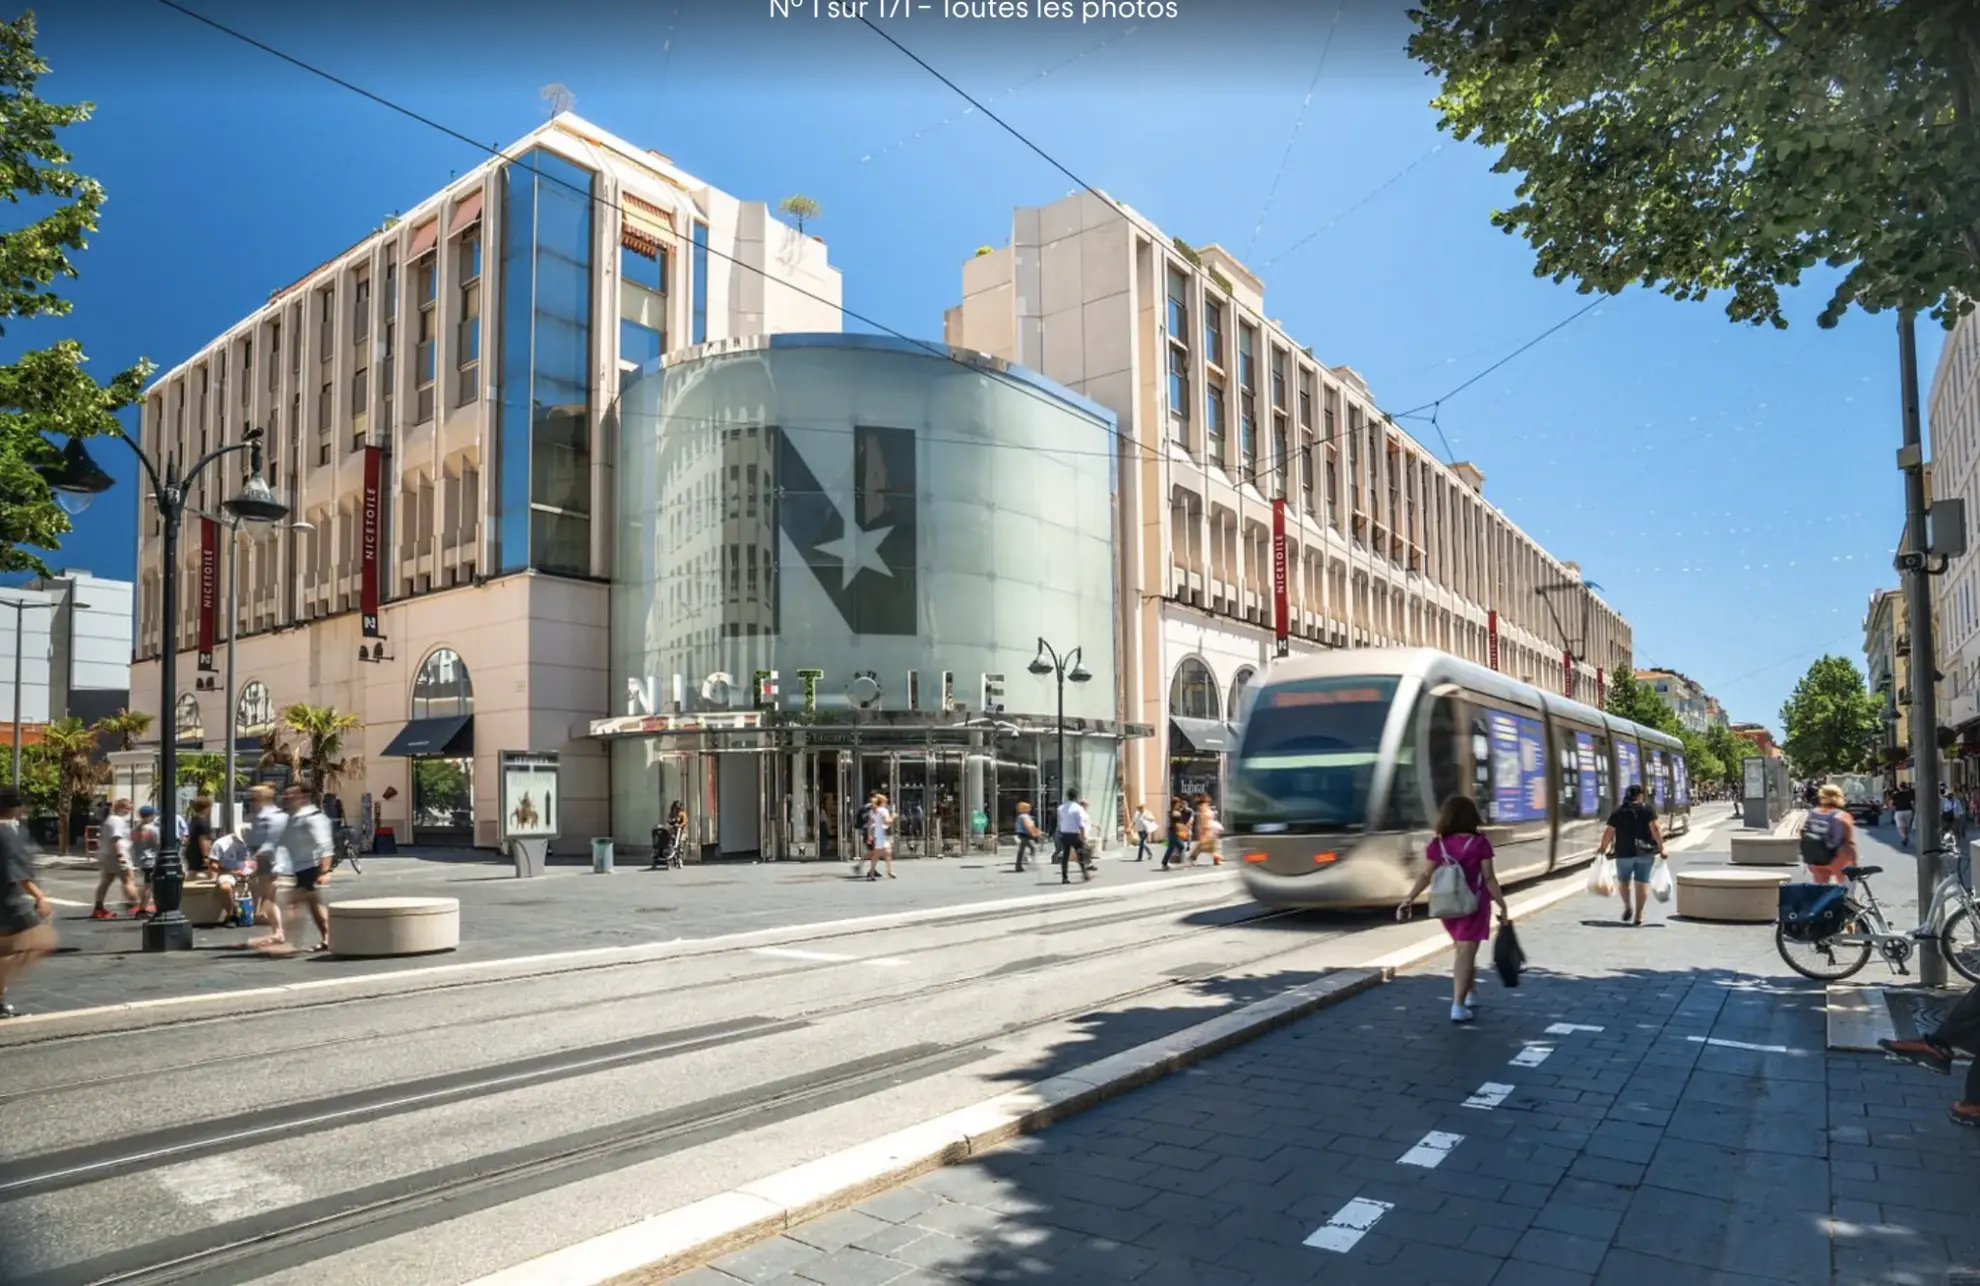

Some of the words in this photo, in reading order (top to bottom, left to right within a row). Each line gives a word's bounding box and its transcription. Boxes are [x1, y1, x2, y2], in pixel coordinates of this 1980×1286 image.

[365, 487, 377, 560] NICETOILE
[203, 550, 213, 608] NICETOILE
[1275, 534, 1284, 594] NICETOILE
[627, 669, 1006, 716] NICETOILE
